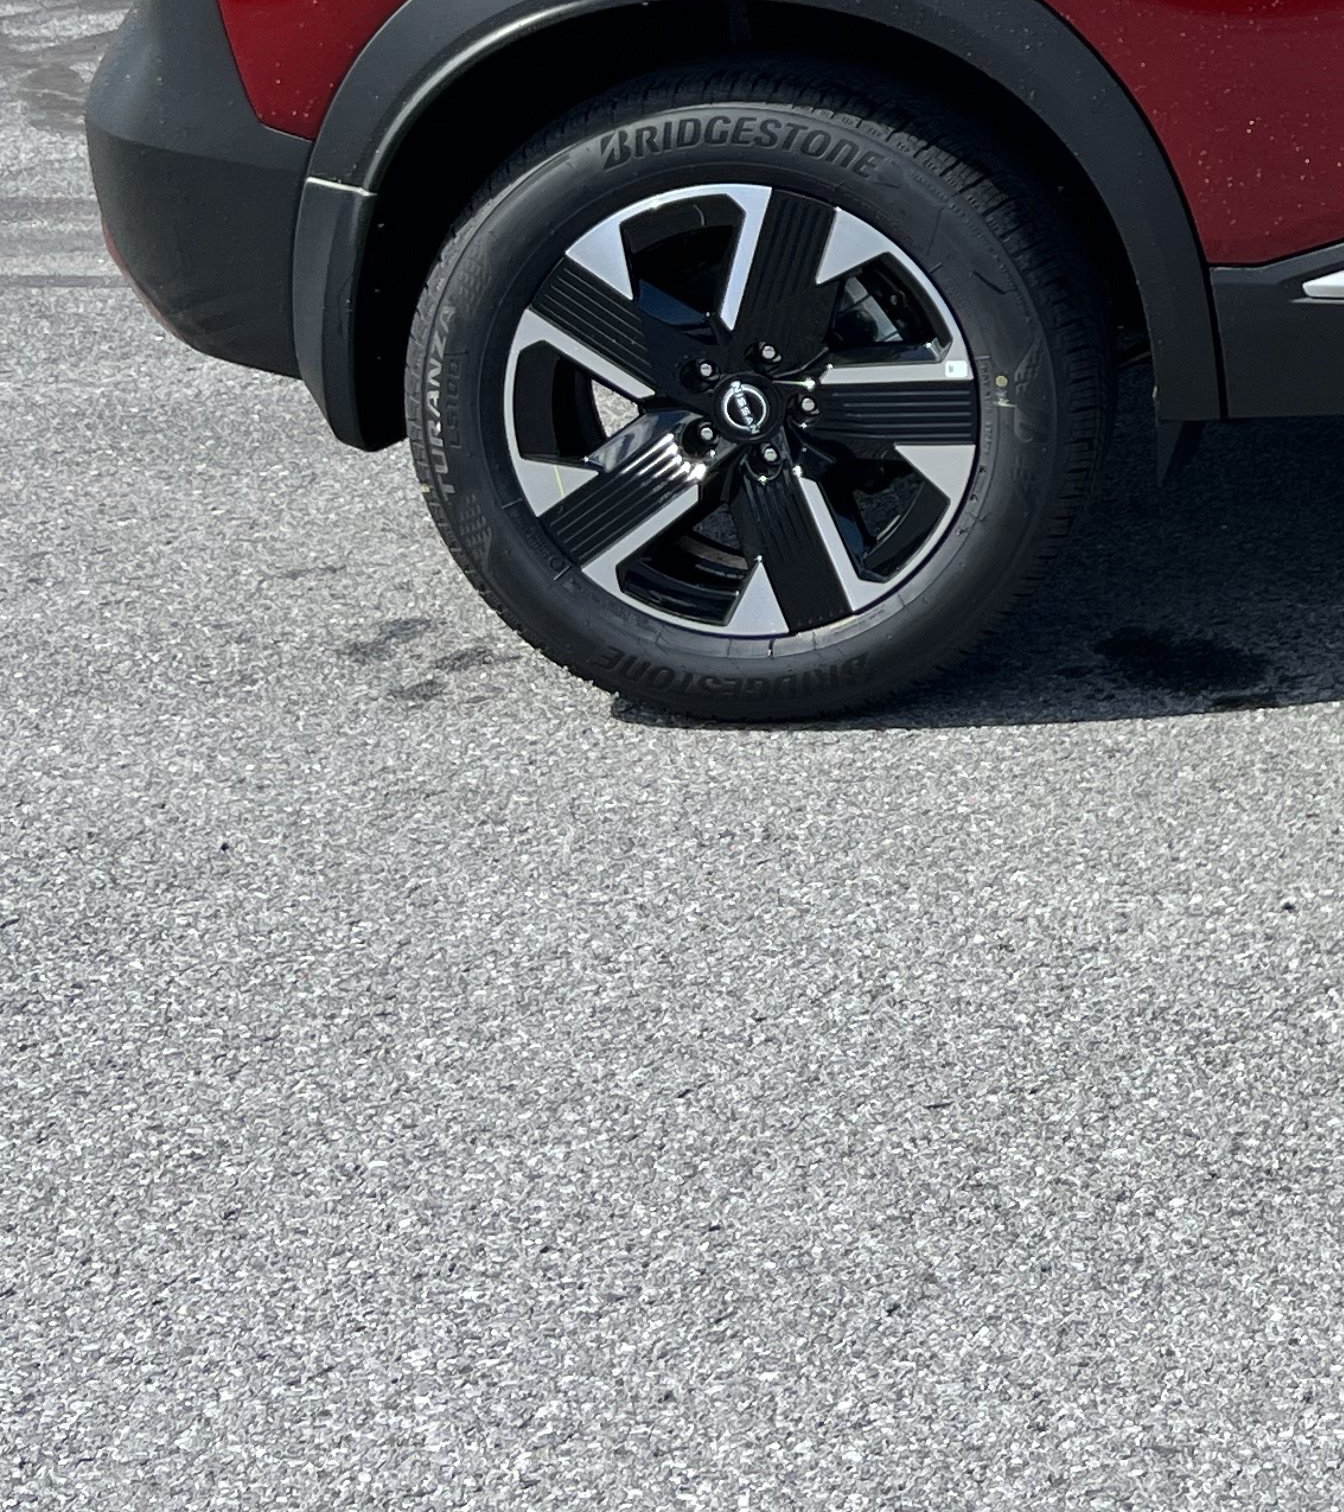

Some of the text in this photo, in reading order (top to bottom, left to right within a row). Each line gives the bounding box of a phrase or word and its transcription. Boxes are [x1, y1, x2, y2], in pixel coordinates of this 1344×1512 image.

[600, 115, 884, 178] BRIDGESTONE
[423, 304, 457, 504] TURANZA
[730, 381, 760, 434] NISSAN
